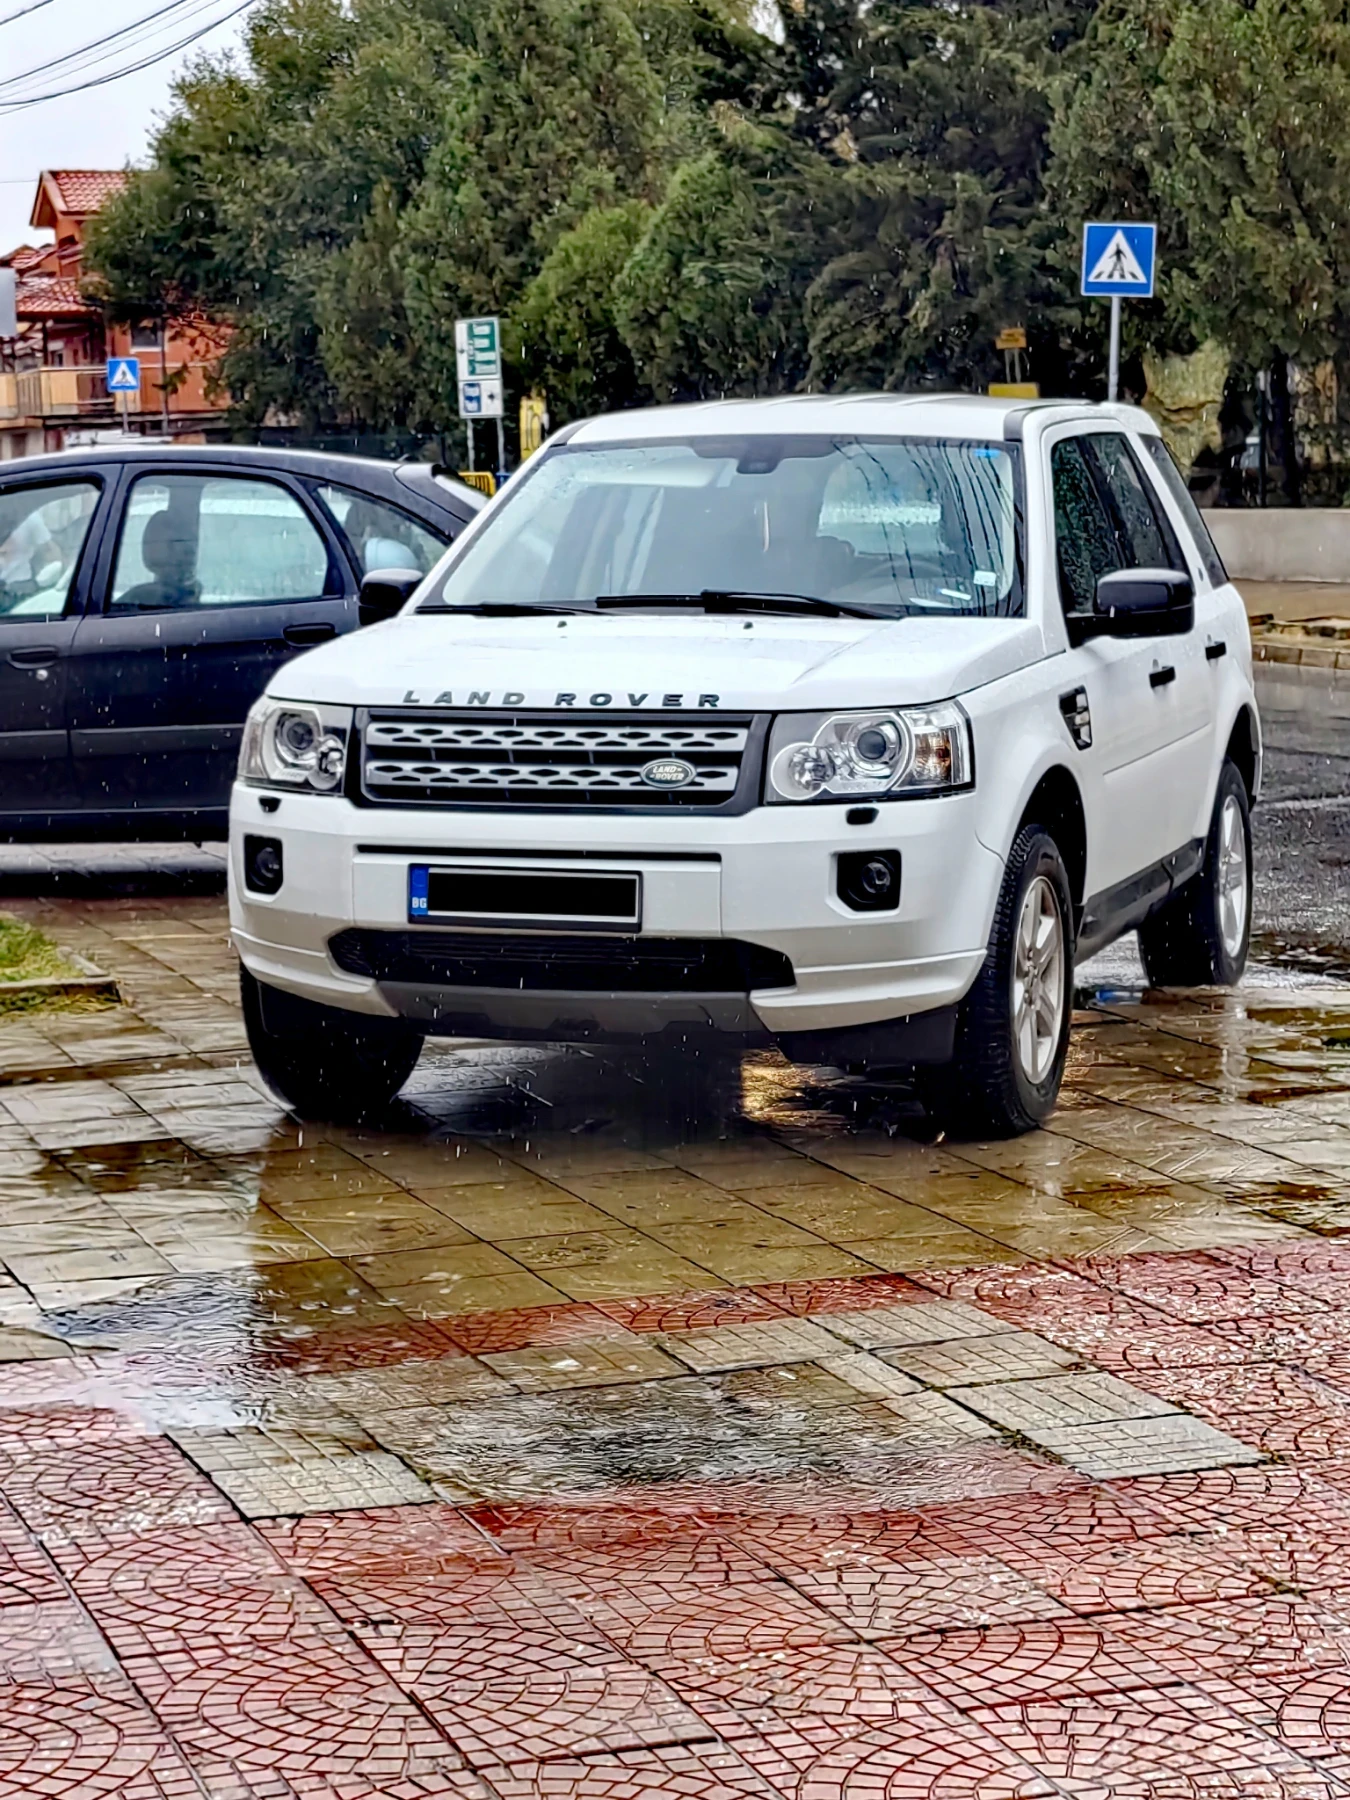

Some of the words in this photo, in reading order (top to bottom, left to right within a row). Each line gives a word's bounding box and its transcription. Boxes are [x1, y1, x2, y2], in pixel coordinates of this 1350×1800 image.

[403, 690, 525, 705] LAND
[554, 692, 720, 707] ROVER
[412, 897, 427, 908] BG
